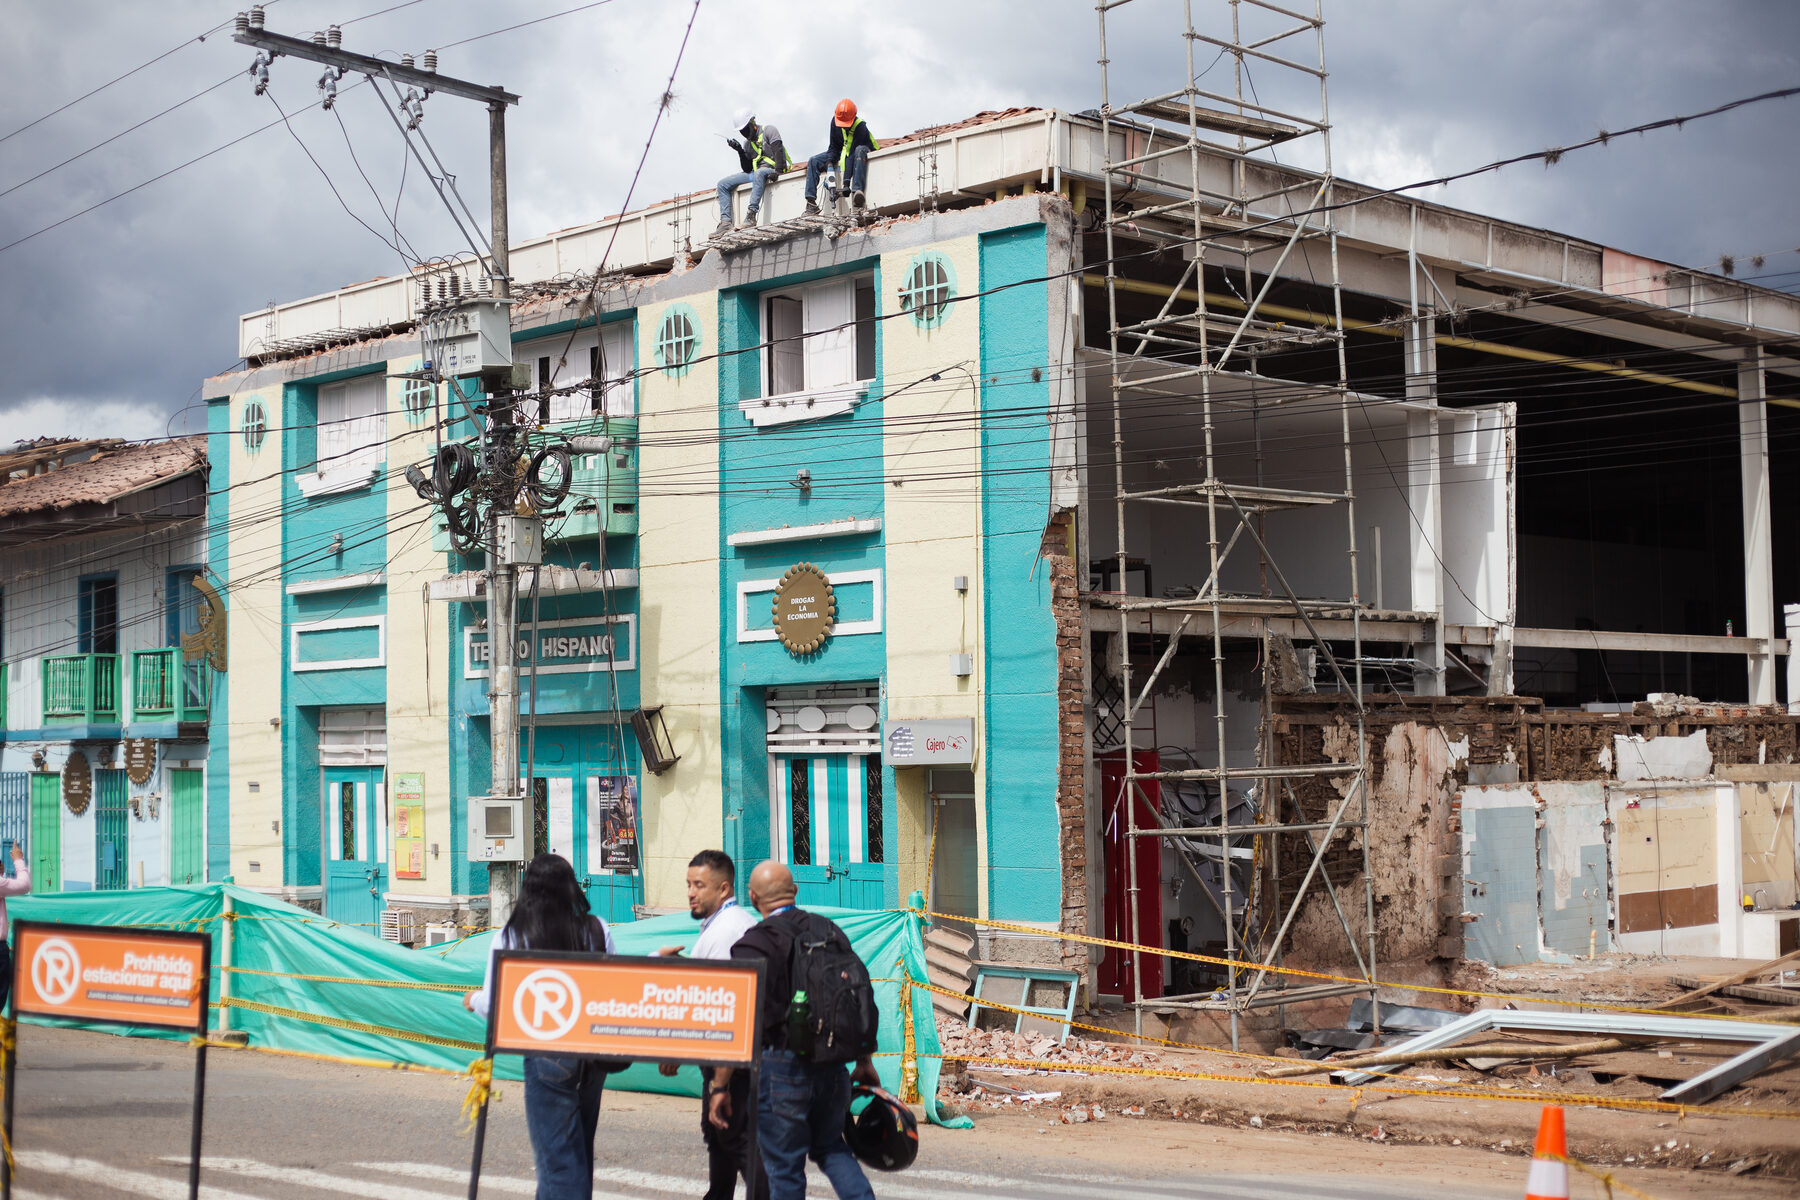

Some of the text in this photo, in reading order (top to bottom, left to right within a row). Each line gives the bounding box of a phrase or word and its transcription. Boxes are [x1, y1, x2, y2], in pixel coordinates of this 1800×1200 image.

[790, 596, 815, 605] DROGAS
[787, 612, 819, 620] ECONOMIA
[471, 634, 615, 662] TEO HISPANO
[926, 738, 946, 754] Cajero
[124, 952, 193, 975] Prohibido
[82, 966, 192, 992] estacionar aquí
[642, 982, 736, 1006] Prohibido
[585, 998, 735, 1026] estacionar aquí
[592, 1025, 618, 1034] Juntos
[619, 1026, 657, 1037] cuidamos
[657, 1028, 671, 1037] del
[671, 1029, 704, 1039] embalse
